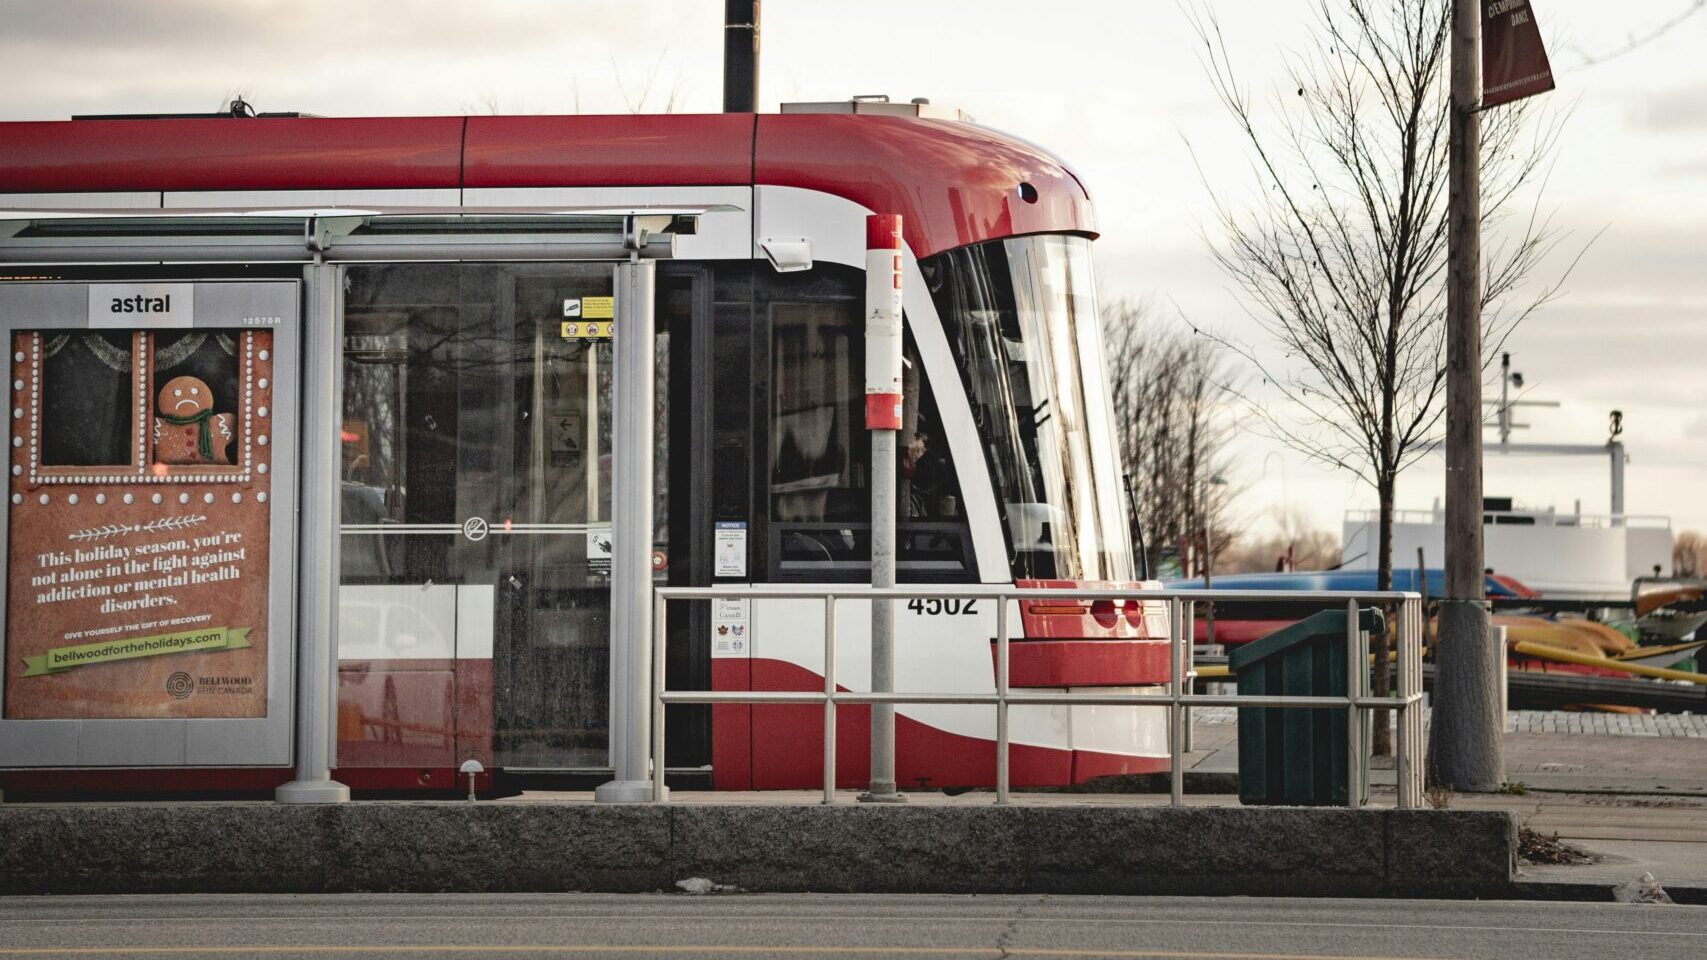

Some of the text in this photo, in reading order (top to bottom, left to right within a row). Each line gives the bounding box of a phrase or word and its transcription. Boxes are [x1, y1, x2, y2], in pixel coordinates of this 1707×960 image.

[111, 294, 170, 313] astral
[38, 552, 72, 568] This
[75, 545, 131, 563] holiday
[193, 530, 242, 552] you're
[31, 547, 246, 587] not alone in the fight against
[36, 565, 240, 604] addiction or mental health
[100, 593, 177, 614] disorders.
[907, 598, 978, 616] 4502
[64, 614, 212, 640] GIVE YOURSELF THE GIFT OF RECOVERY
[54, 632, 222, 663] bellwoodfortheholidays.com
[199, 677, 252, 685] BELLWOOD
[217, 686, 253, 694] CANADA
